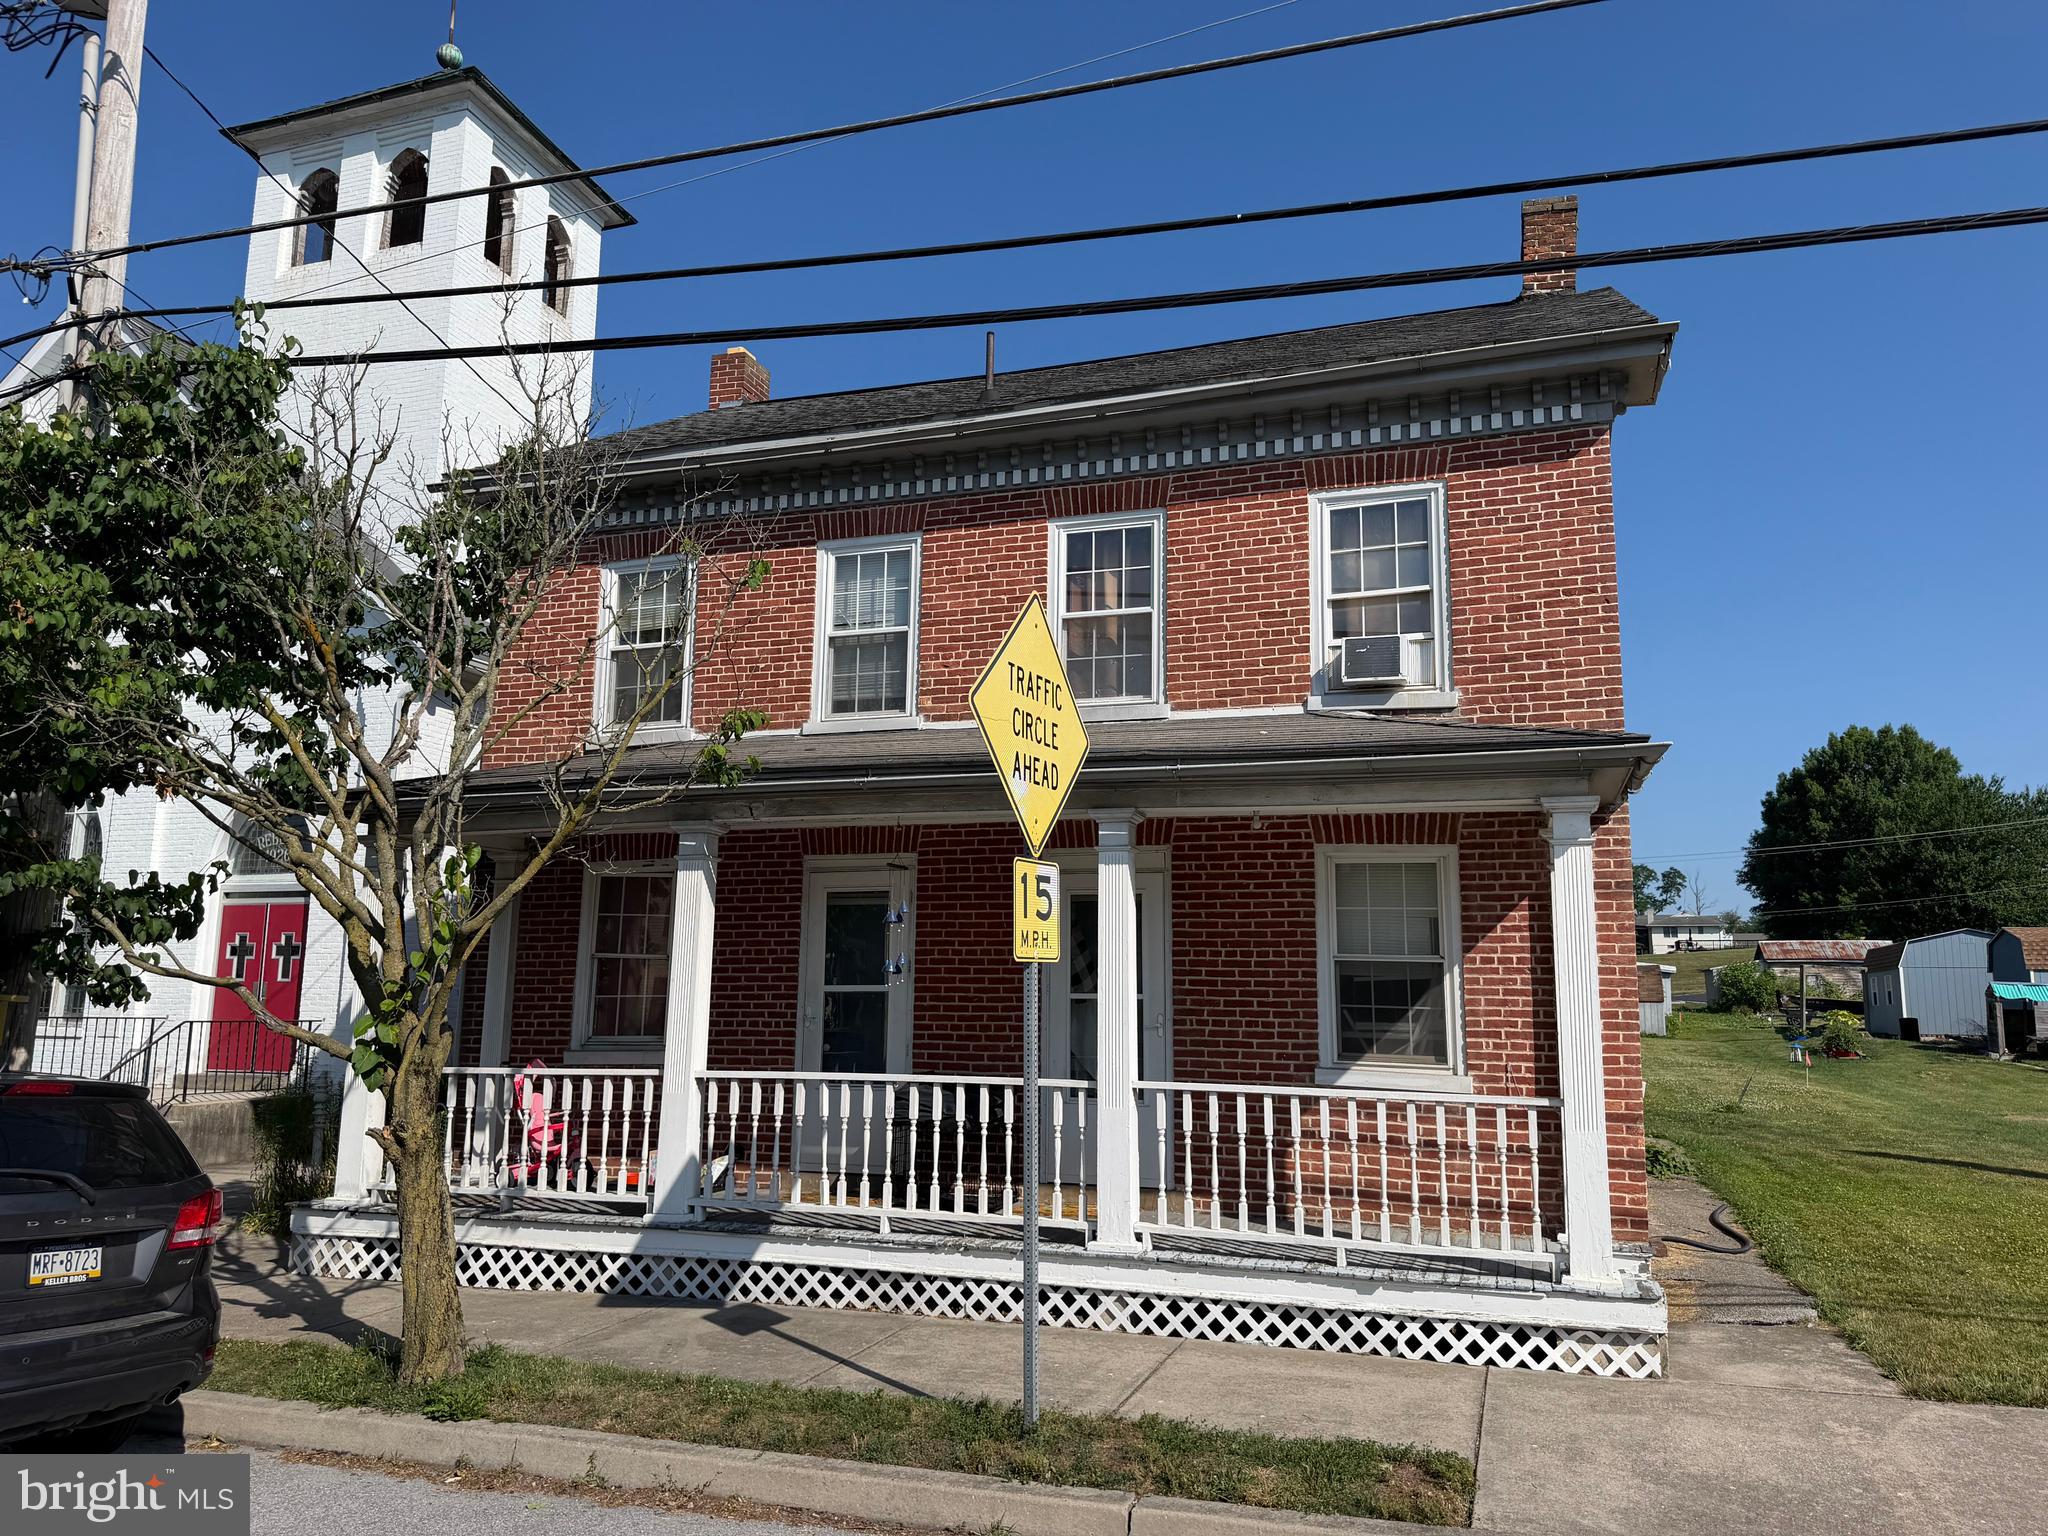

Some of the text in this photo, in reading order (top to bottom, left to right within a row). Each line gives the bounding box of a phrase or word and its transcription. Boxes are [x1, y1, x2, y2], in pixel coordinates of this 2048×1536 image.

[1008, 661, 1062, 712] TRAFFIC
[1012, 707, 1059, 750] CIRCLE
[1012, 751, 1059, 791] AHEAD
[1021, 872, 1052, 921] 15
[1021, 930, 1052, 949] M.P.H.
[44, 1274, 87, 1286] KELLER BROS
